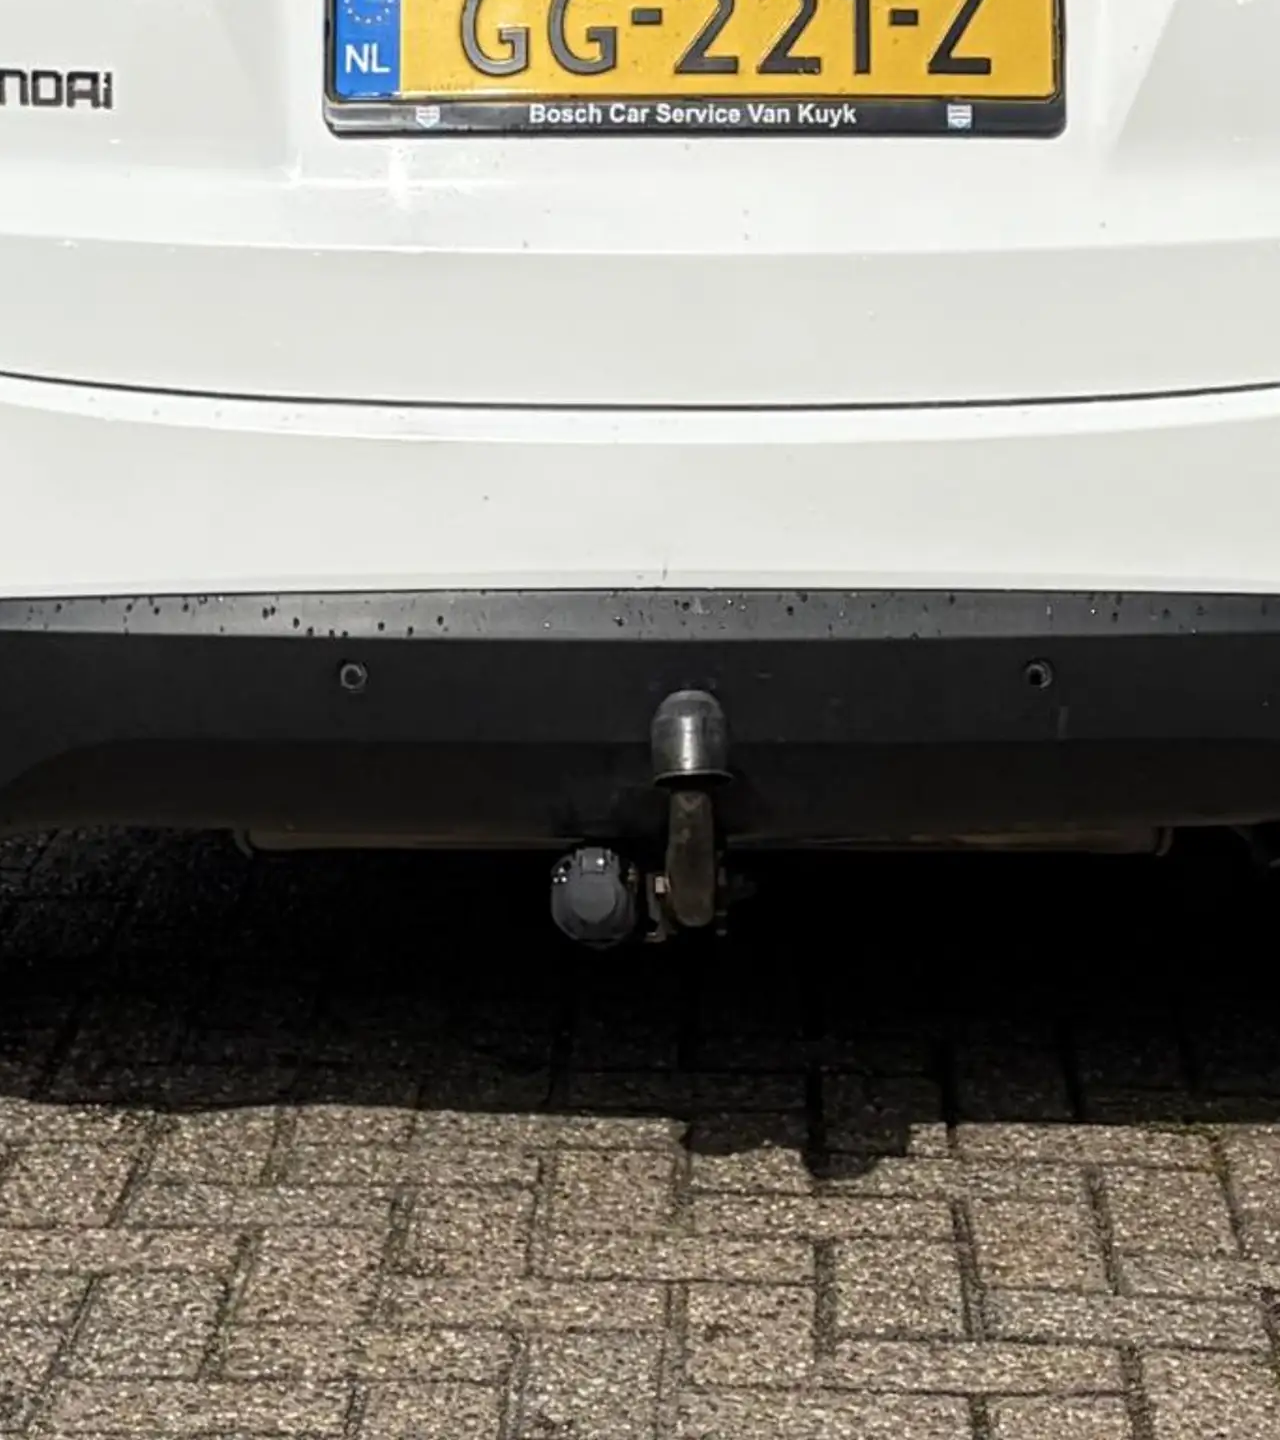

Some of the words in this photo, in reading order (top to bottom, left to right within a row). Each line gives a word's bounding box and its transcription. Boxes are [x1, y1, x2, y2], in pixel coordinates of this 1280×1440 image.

[345, 43, 391, 74] NL
[529, 103, 602, 124] Bosch
[609, 103, 650, 123] Car
[655, 103, 741, 124] Service
[747, 103, 790, 123] Van
[798, 104, 857, 128] Kuyk
